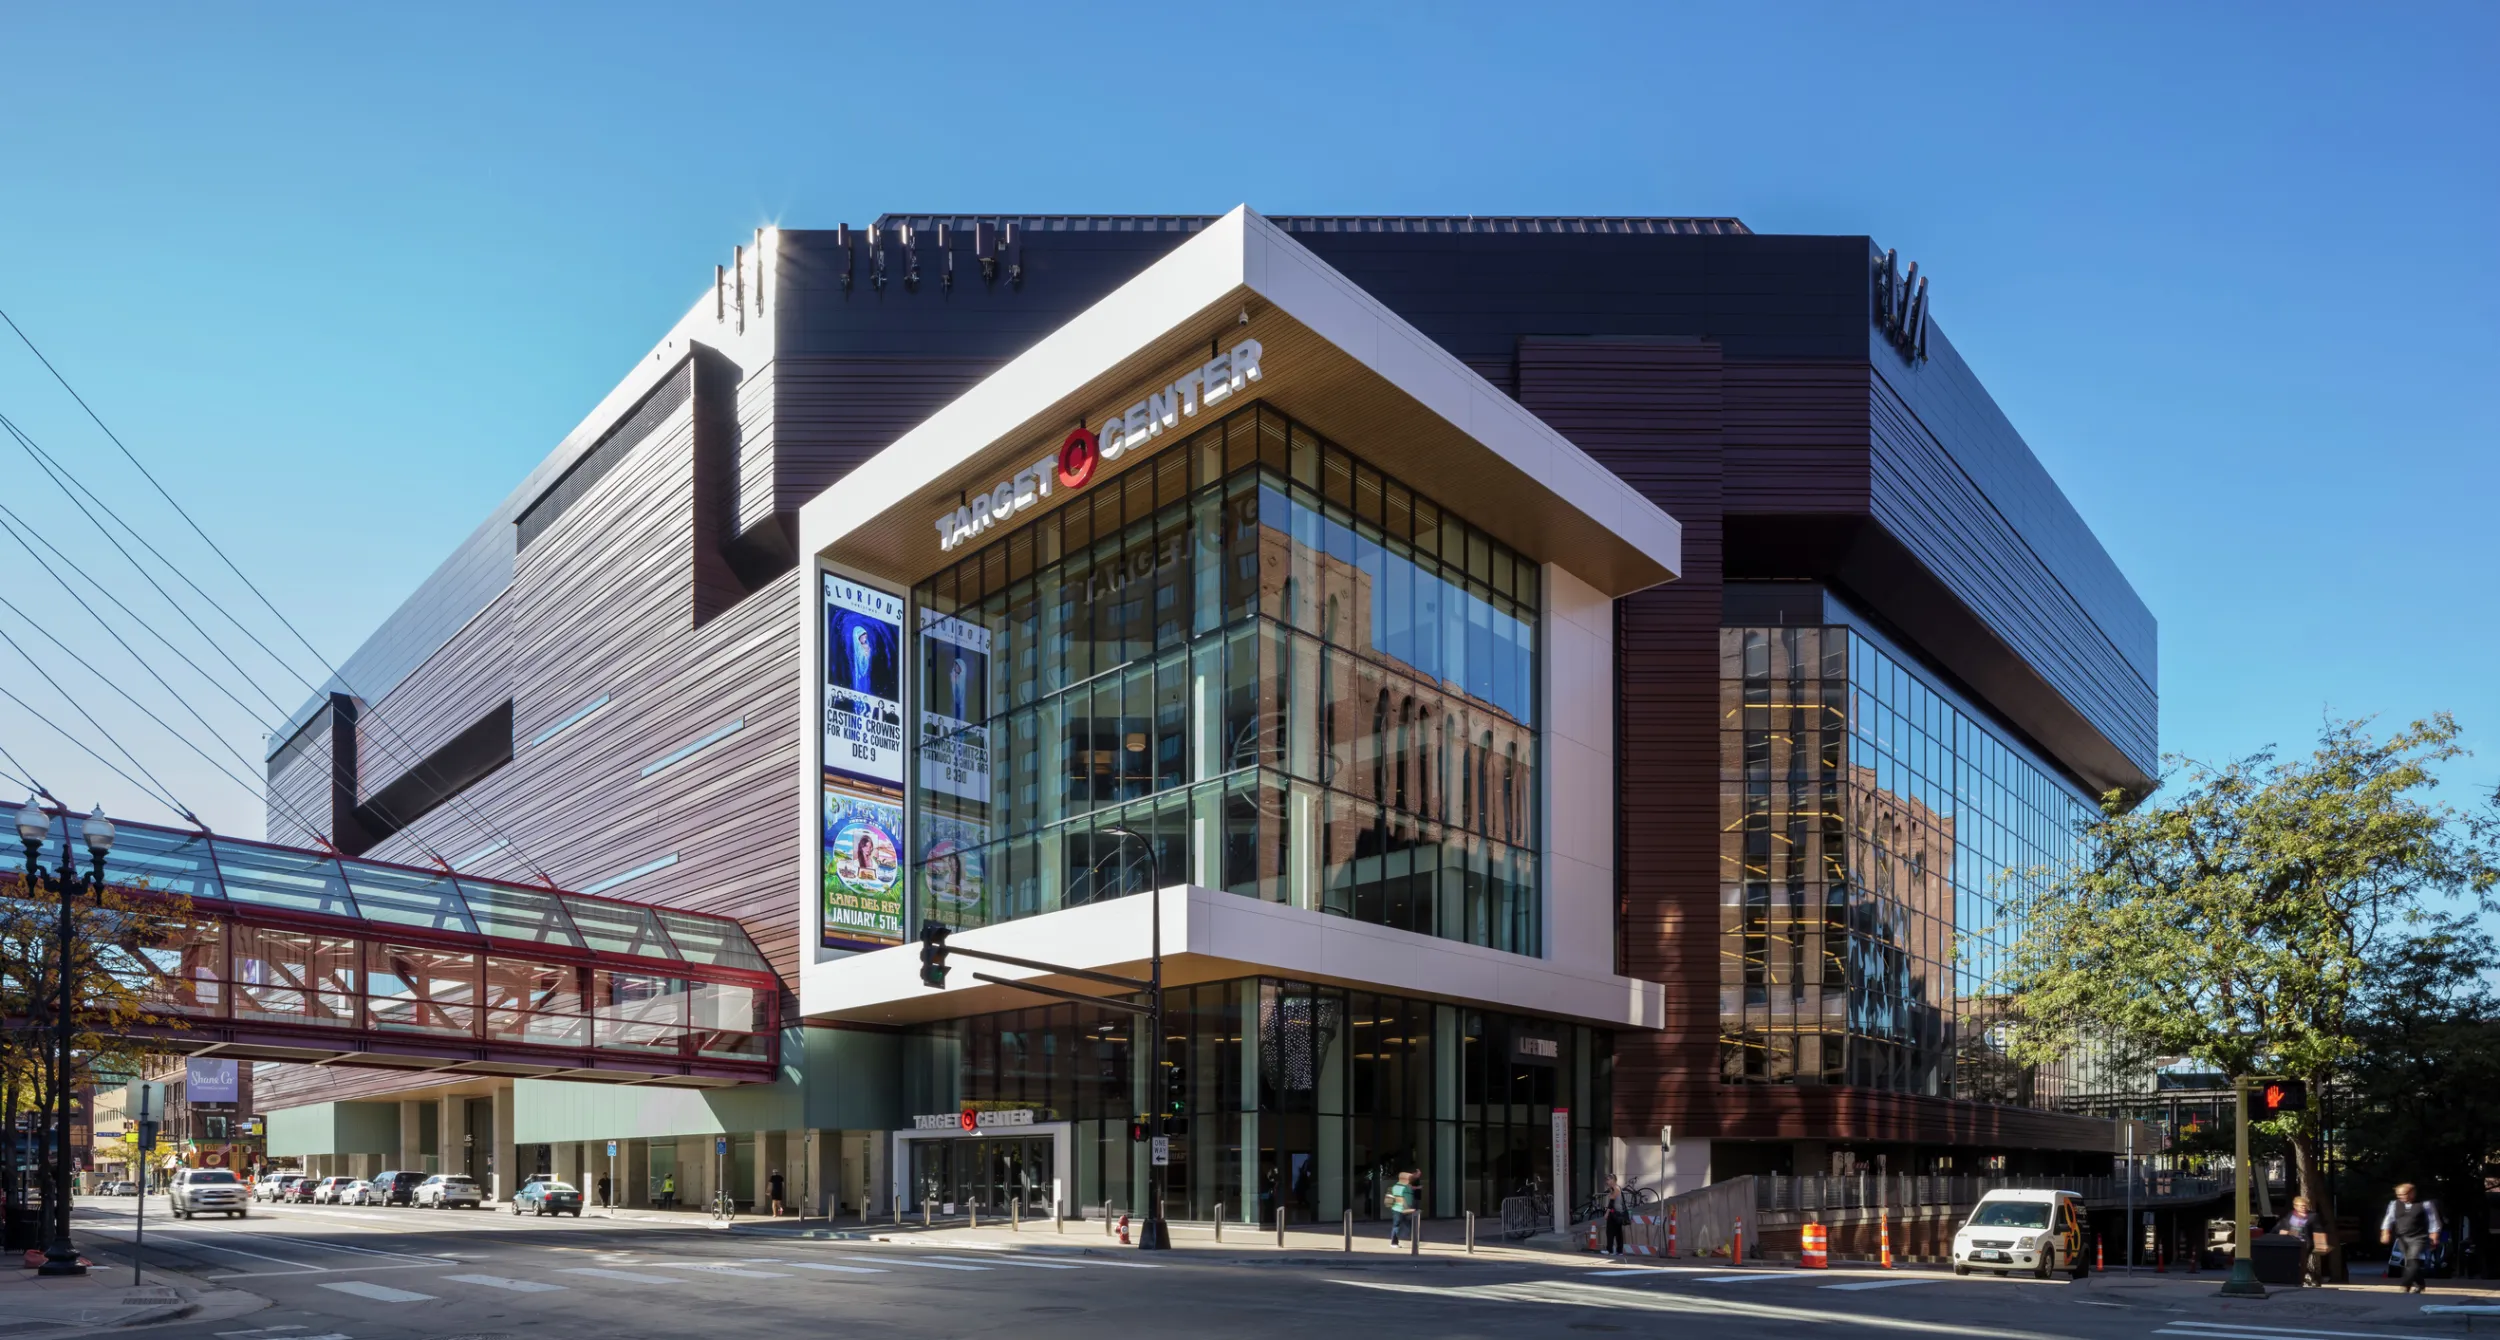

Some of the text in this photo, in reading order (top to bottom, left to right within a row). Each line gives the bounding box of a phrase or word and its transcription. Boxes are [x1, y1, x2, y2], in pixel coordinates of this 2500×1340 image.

[935, 338, 1264, 552] TARGET CENTER
[825, 584, 903, 620] GLORIOUS
[827, 709, 900, 740] CASTING CROWNS
[827, 723, 900, 752] FOR KING & COUNTRY
[852, 743, 876, 762] DEC 9
[829, 892, 901, 914] LANA DEL REY
[832, 907, 898, 931] JANUARY 5TH
[191, 1070, 220, 1086] Shane
[913, 1109, 1034, 1130] TARGET CENTER
